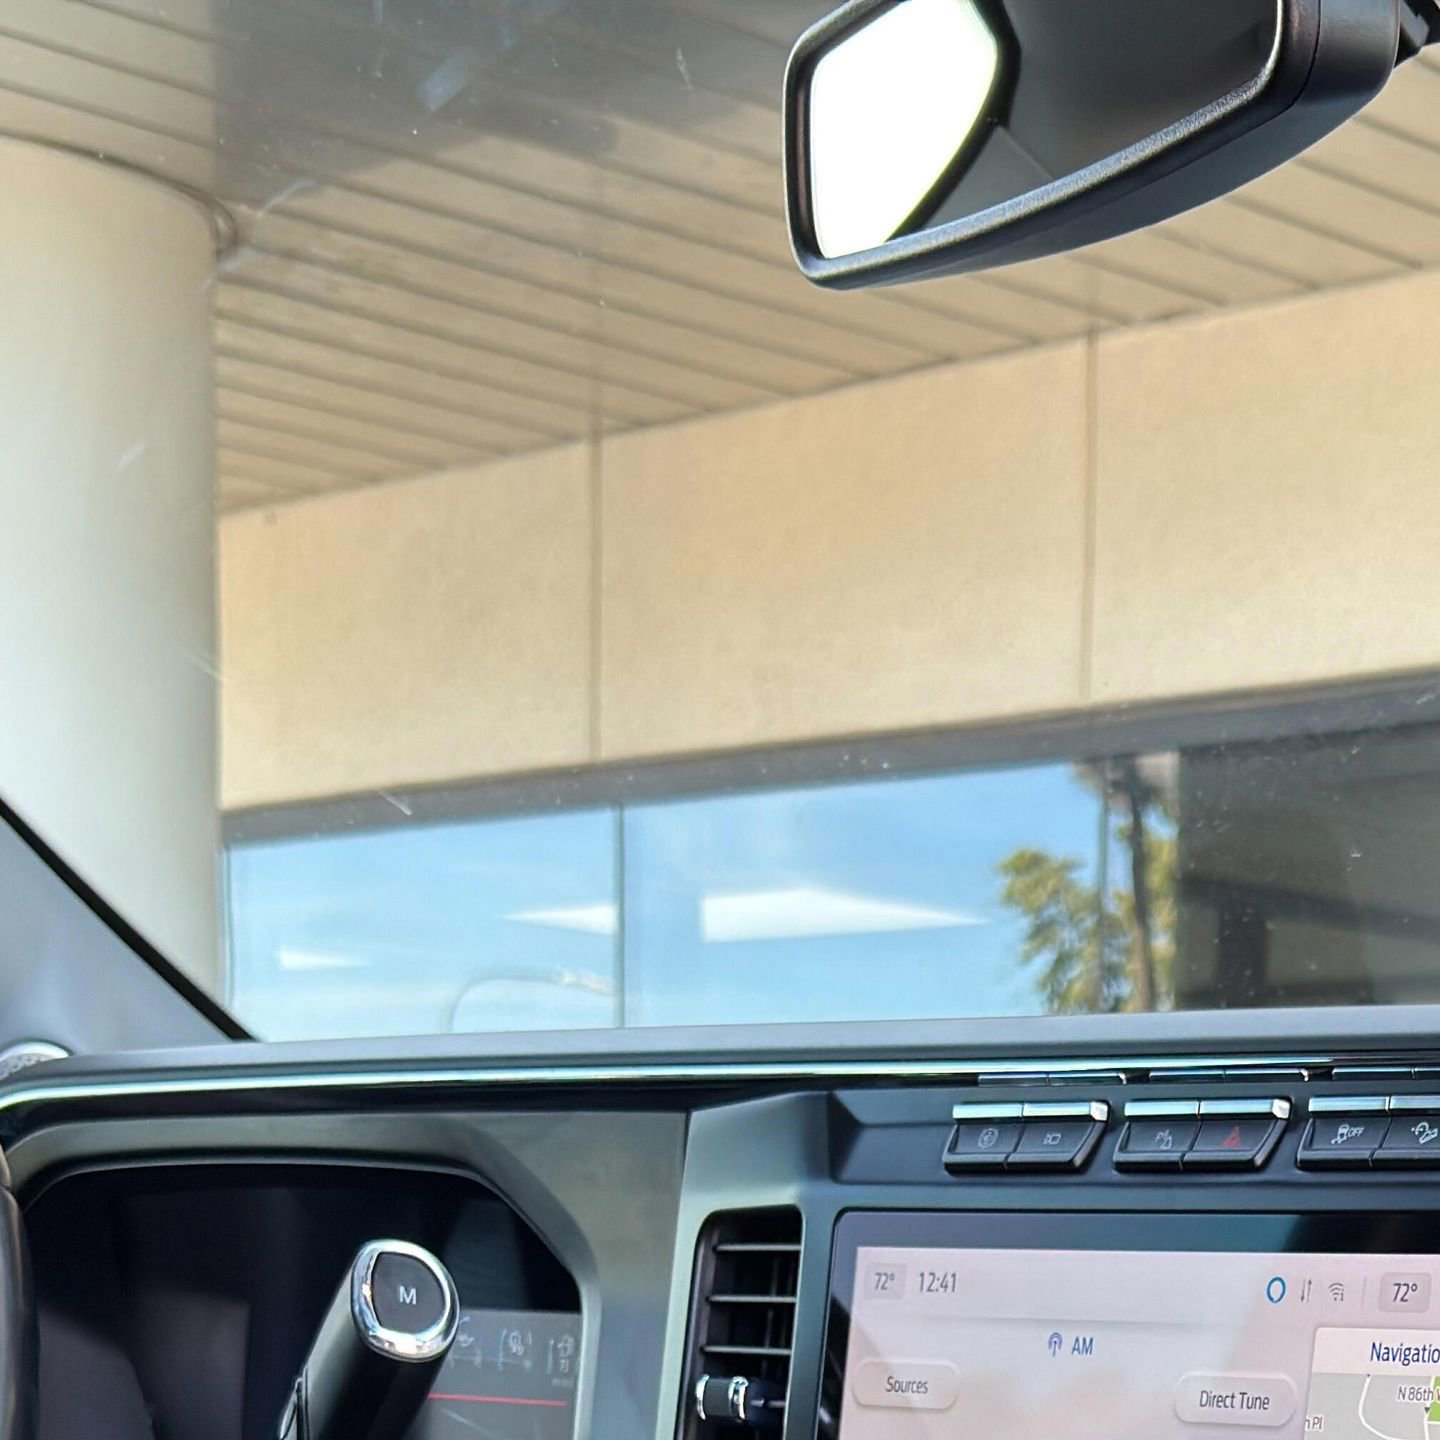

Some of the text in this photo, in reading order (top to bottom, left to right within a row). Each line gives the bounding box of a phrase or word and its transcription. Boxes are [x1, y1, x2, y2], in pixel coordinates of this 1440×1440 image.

[918, 1272, 957, 1293] 12:41
[398, 1286, 417, 1305] M
[1392, 1283, 1418, 1303] 72°
[1071, 1337, 1094, 1356] AM
[885, 1376, 929, 1395] Sources
[1398, 1387, 1406, 1400] N
[1408, 1387, 1434, 1402] 86th
[1199, 1390, 1270, 1411] Direct Tune
